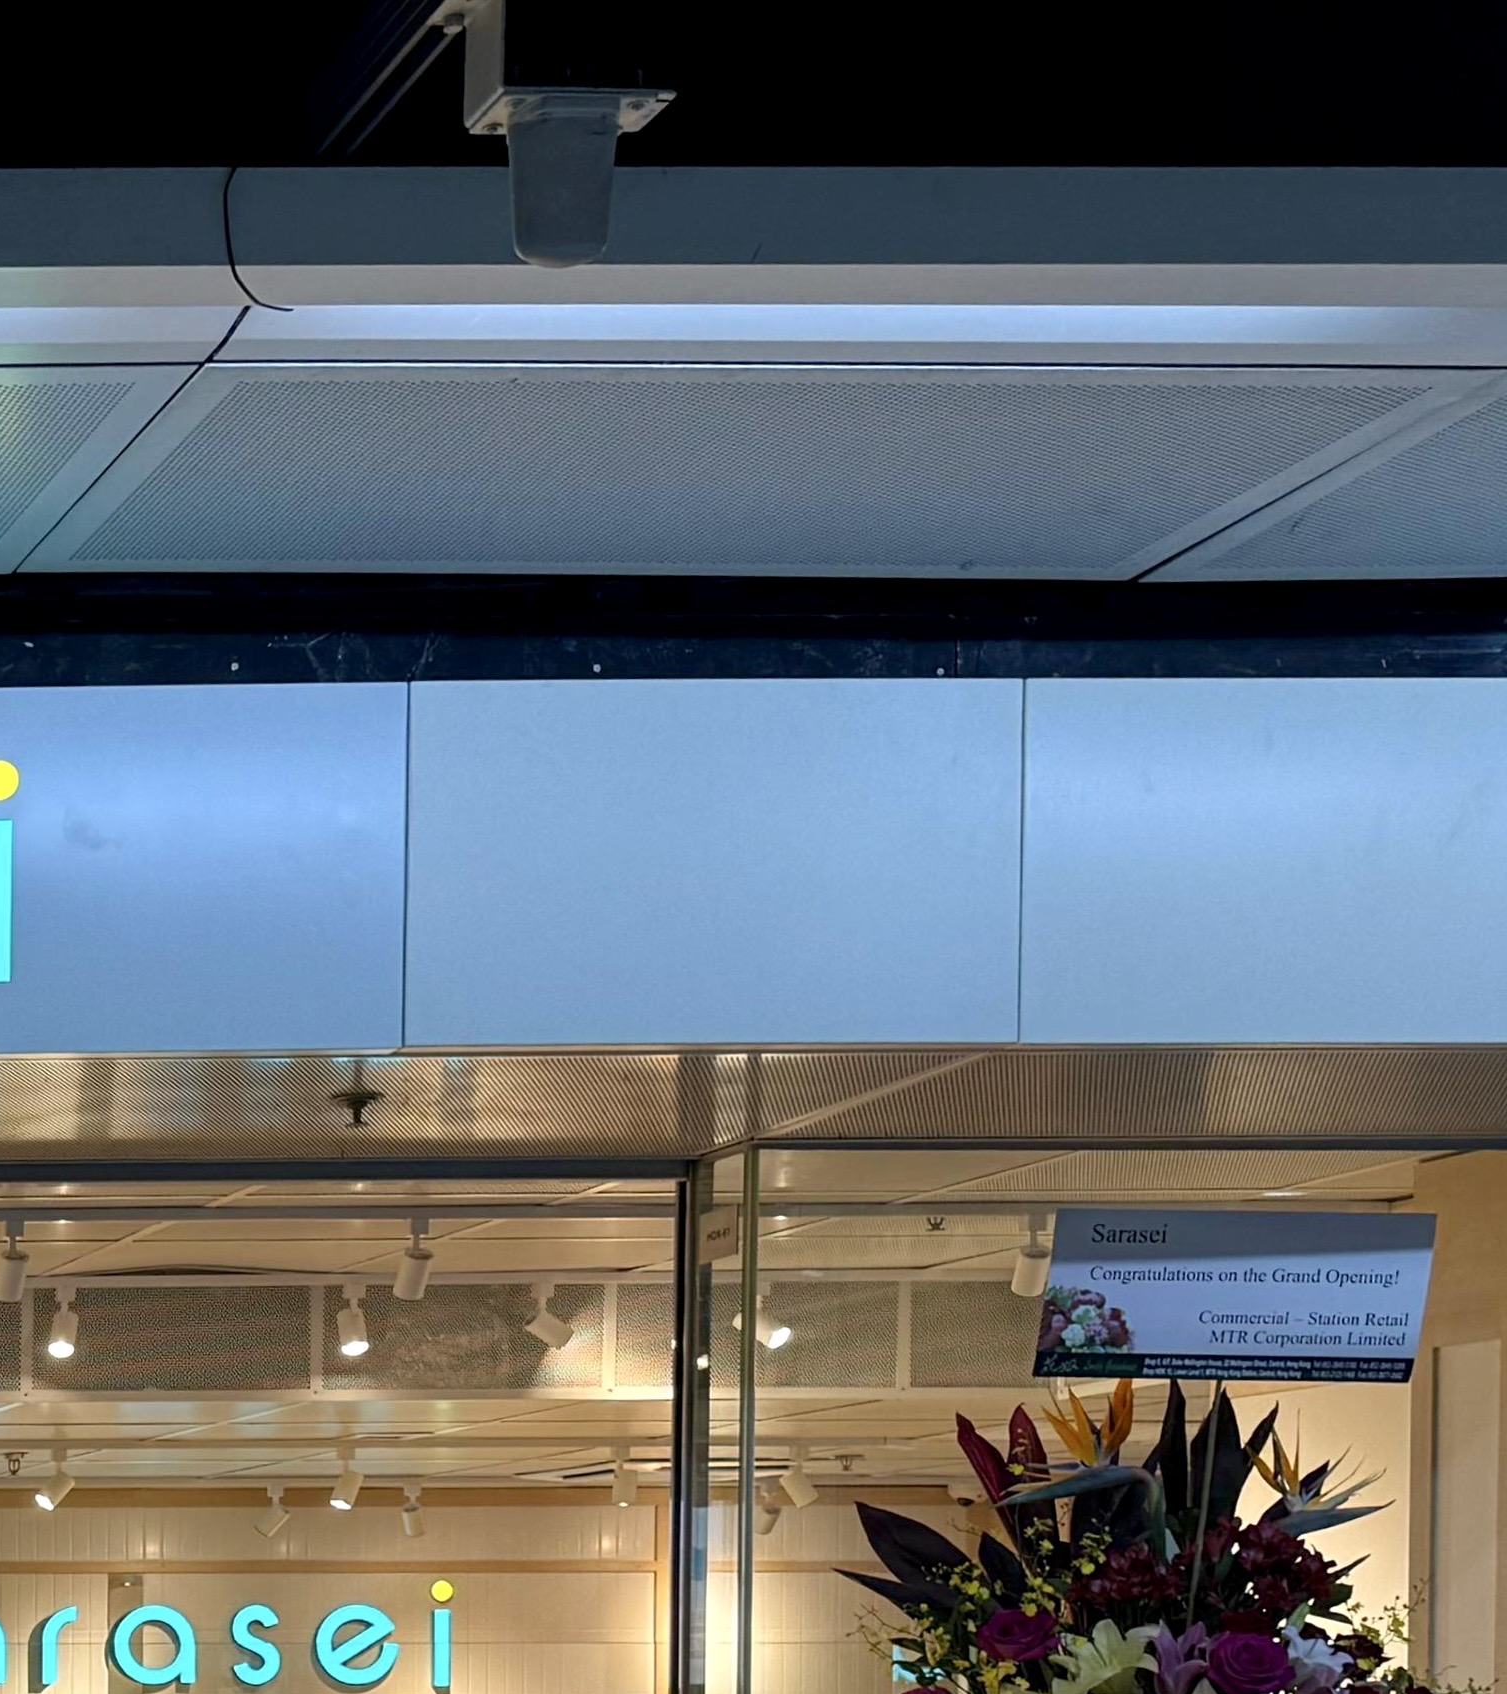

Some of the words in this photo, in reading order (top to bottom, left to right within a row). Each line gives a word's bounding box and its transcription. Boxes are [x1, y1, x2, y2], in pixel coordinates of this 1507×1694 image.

[1091, 1223, 1168, 1244] Sarasei
[1090, 1266, 1213, 1283] Congratulations
[1218, 1270, 1238, 1282] on
[1243, 1268, 1266, 1283] the
[1272, 1268, 1321, 1284] Grand
[1325, 1269, 1400, 1287] Opening!
[1199, 1310, 1289, 1326] Commercial
[1308, 1311, 1360, 1327] Station
[1365, 1311, 1409, 1327] Retail
[1209, 1330, 1248, 1344] MTR
[1253, 1330, 1343, 1347] Corporation
[1347, 1331, 1406, 1347] Limited
